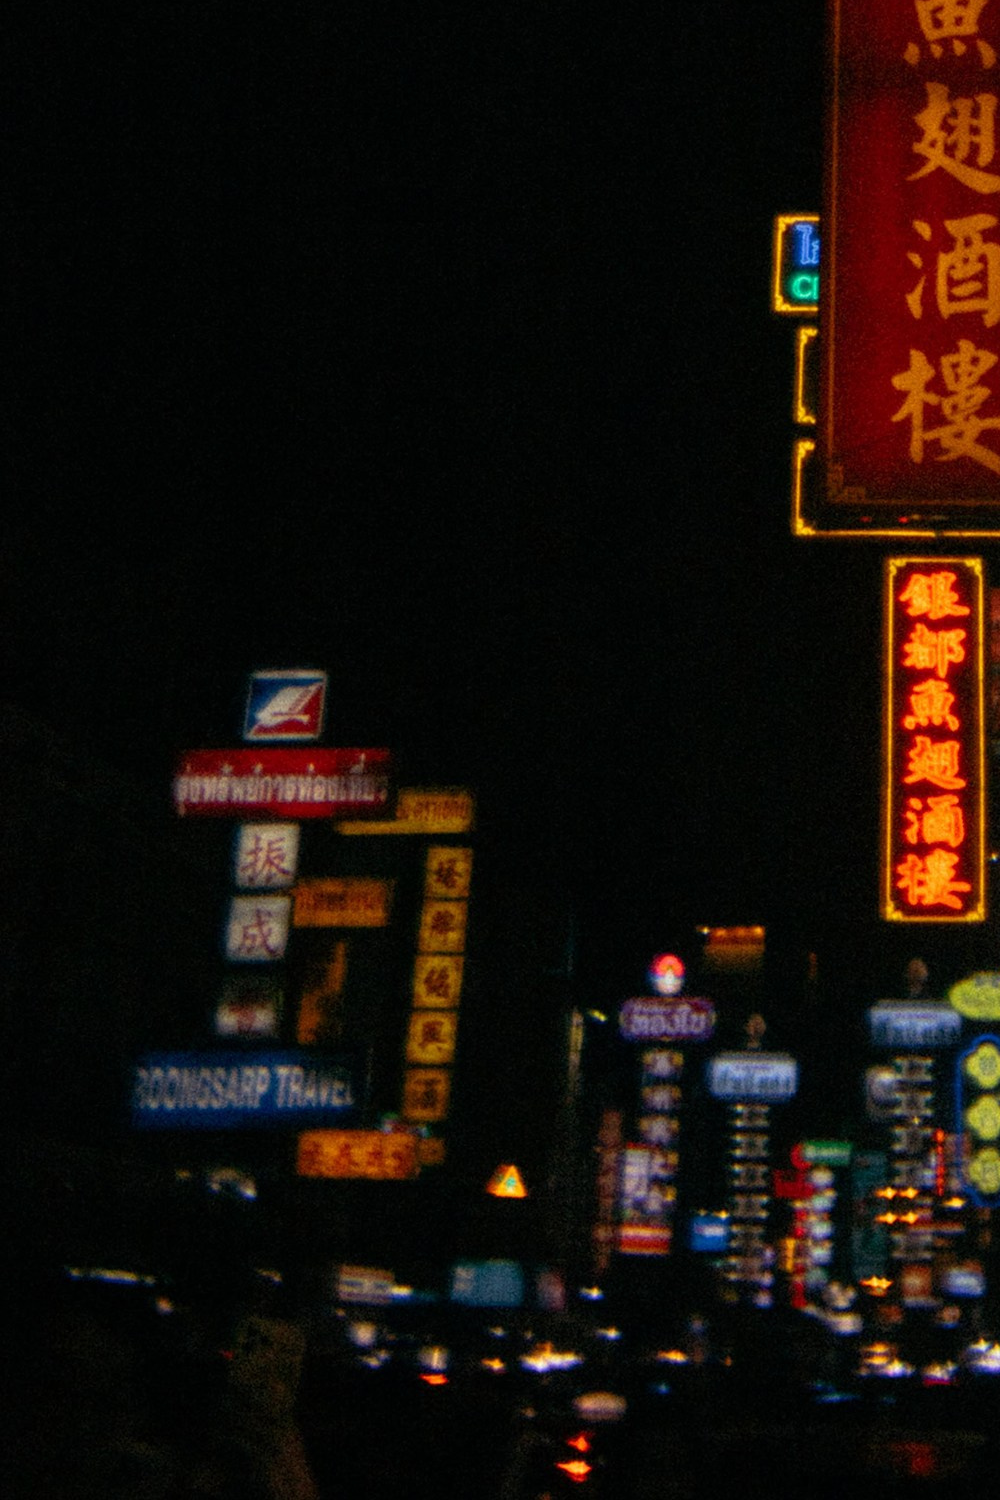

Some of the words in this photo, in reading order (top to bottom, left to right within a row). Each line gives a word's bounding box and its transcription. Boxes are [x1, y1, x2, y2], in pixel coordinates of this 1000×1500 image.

[896, 570, 972, 911] 銀都魚翅酒樓
[274, 1063, 354, 1109] TRAVEL
